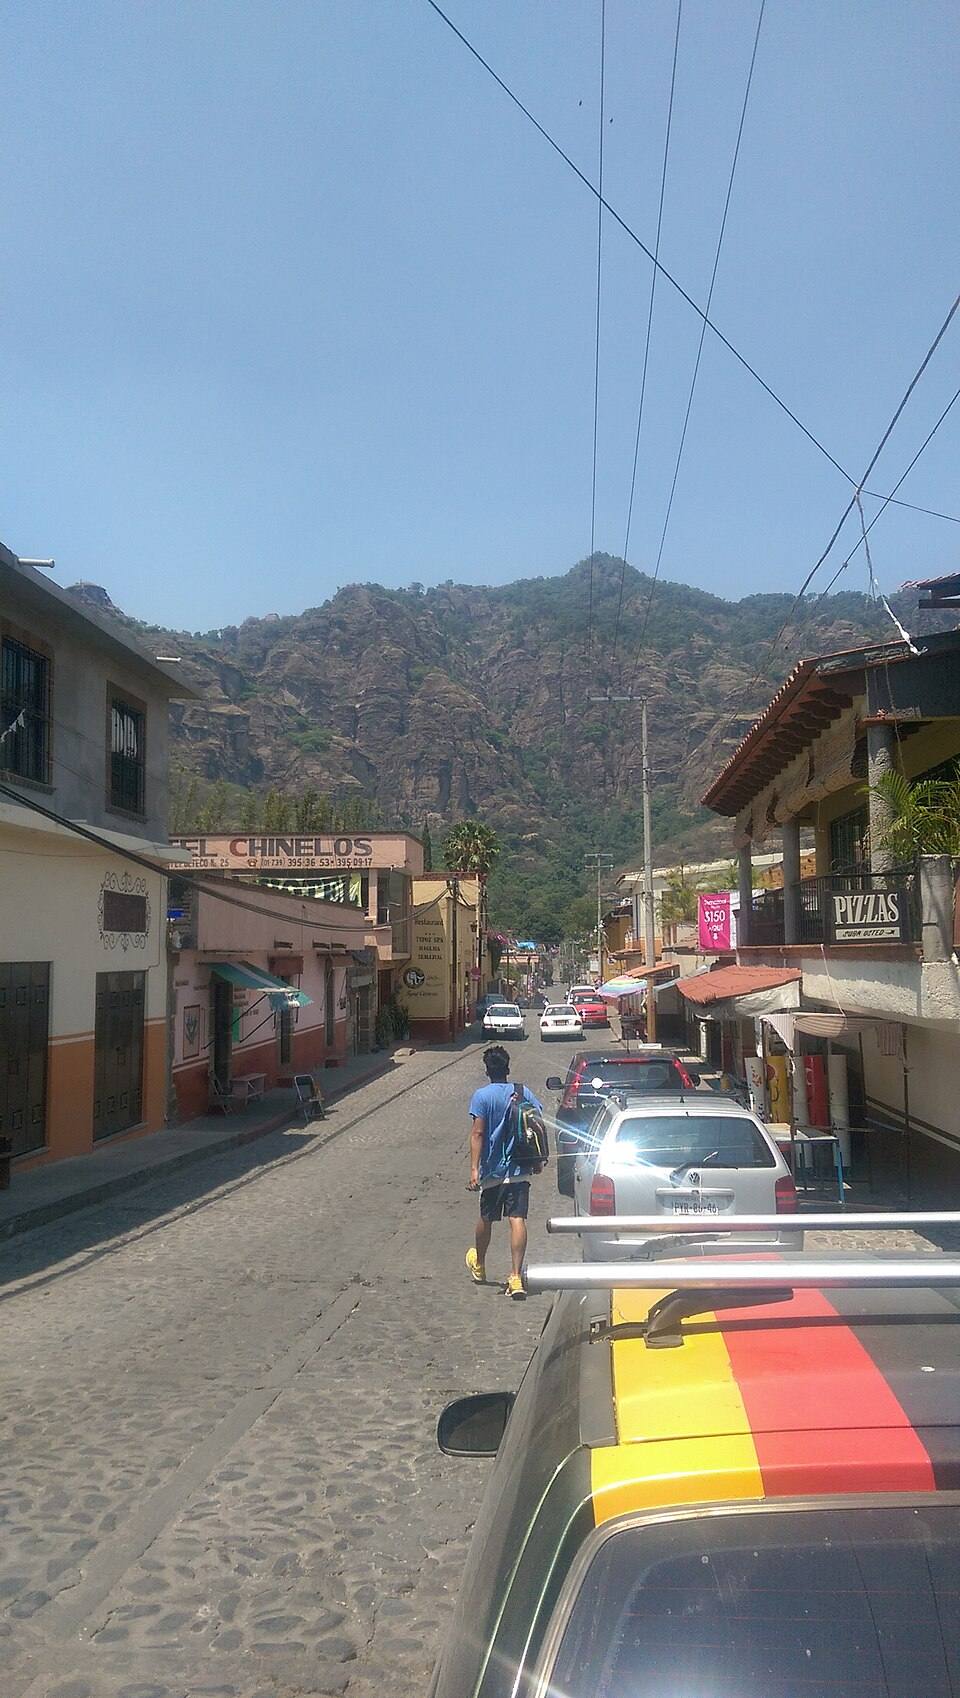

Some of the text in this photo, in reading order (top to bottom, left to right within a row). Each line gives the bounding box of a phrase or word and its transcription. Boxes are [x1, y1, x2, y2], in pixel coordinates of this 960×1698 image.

[230, 838, 373, 857] CHINELOS
[704, 910, 725, 922] $150
[833, 893, 899, 924] PIZZAS
